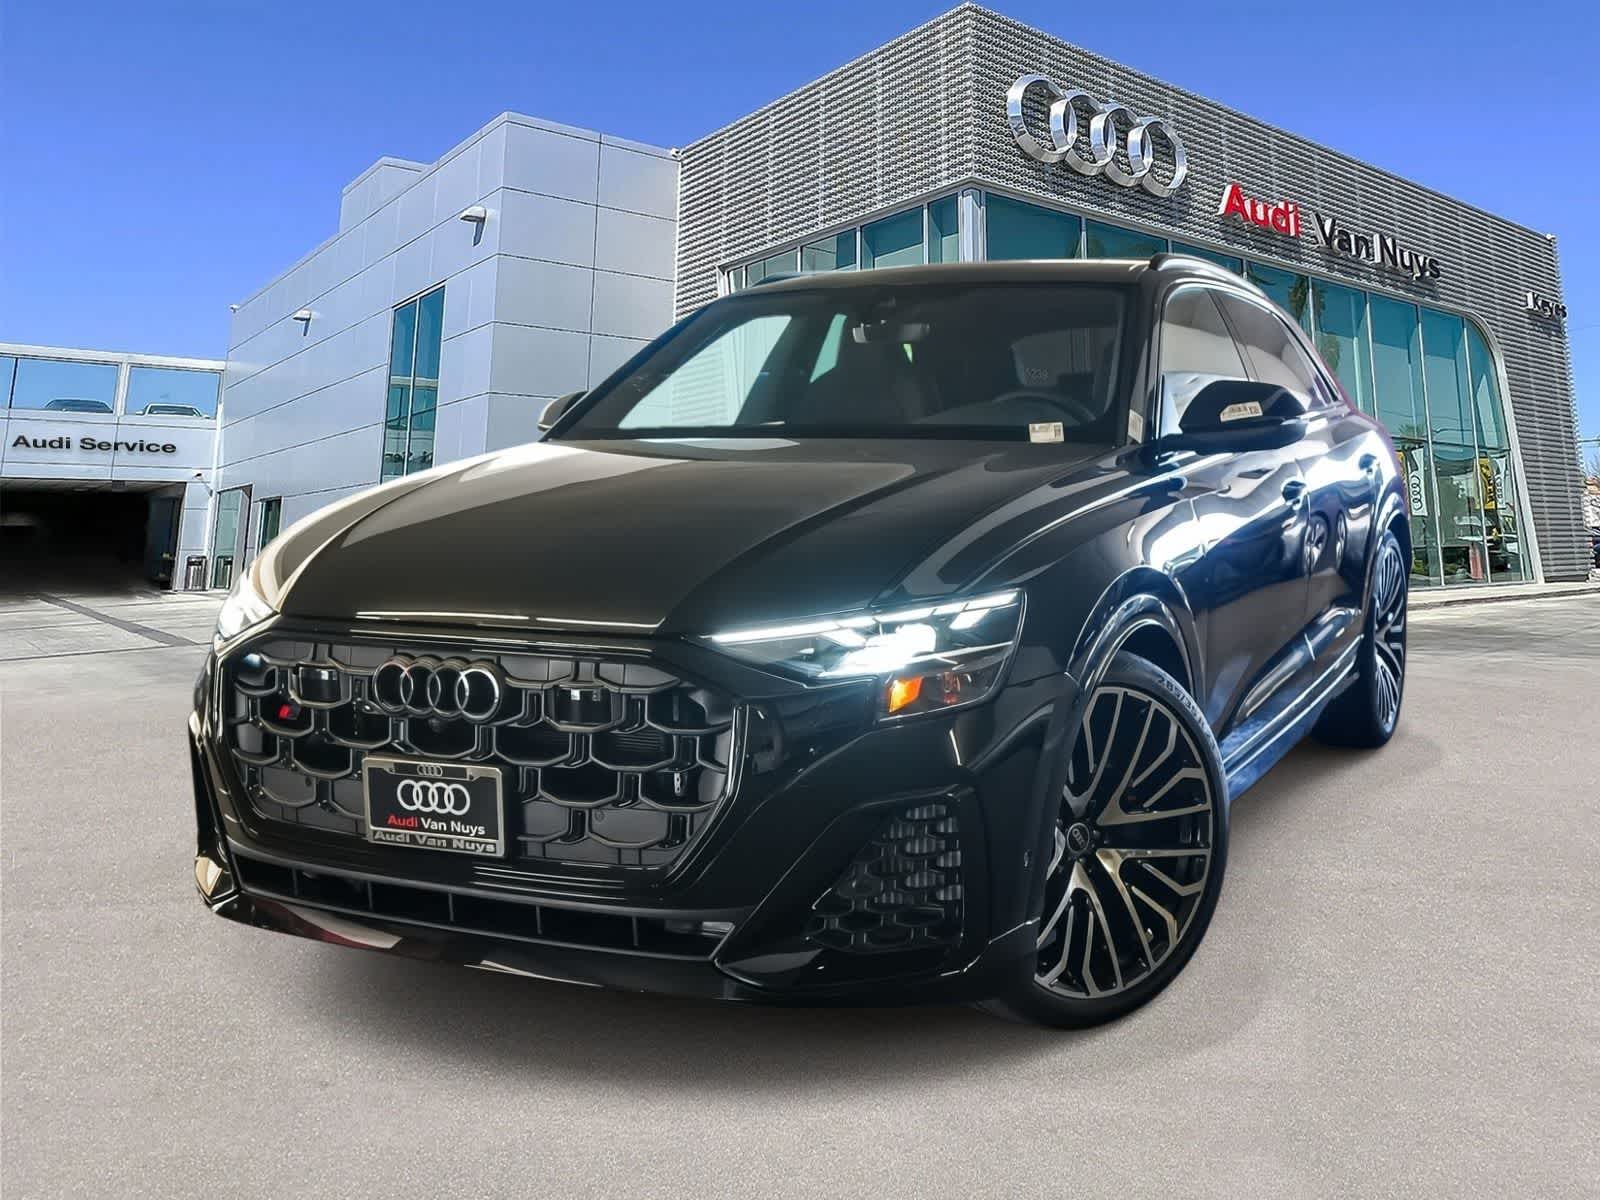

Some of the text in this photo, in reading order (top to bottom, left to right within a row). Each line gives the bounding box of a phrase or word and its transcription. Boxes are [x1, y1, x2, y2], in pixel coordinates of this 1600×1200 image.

[1217, 183, 1442, 280] Audi Van Nuys
[12, 435, 177, 453] Audi Service
[387, 815, 486, 836] Audi Van Nuys
[374, 831, 496, 853] Audi Van Nuys
